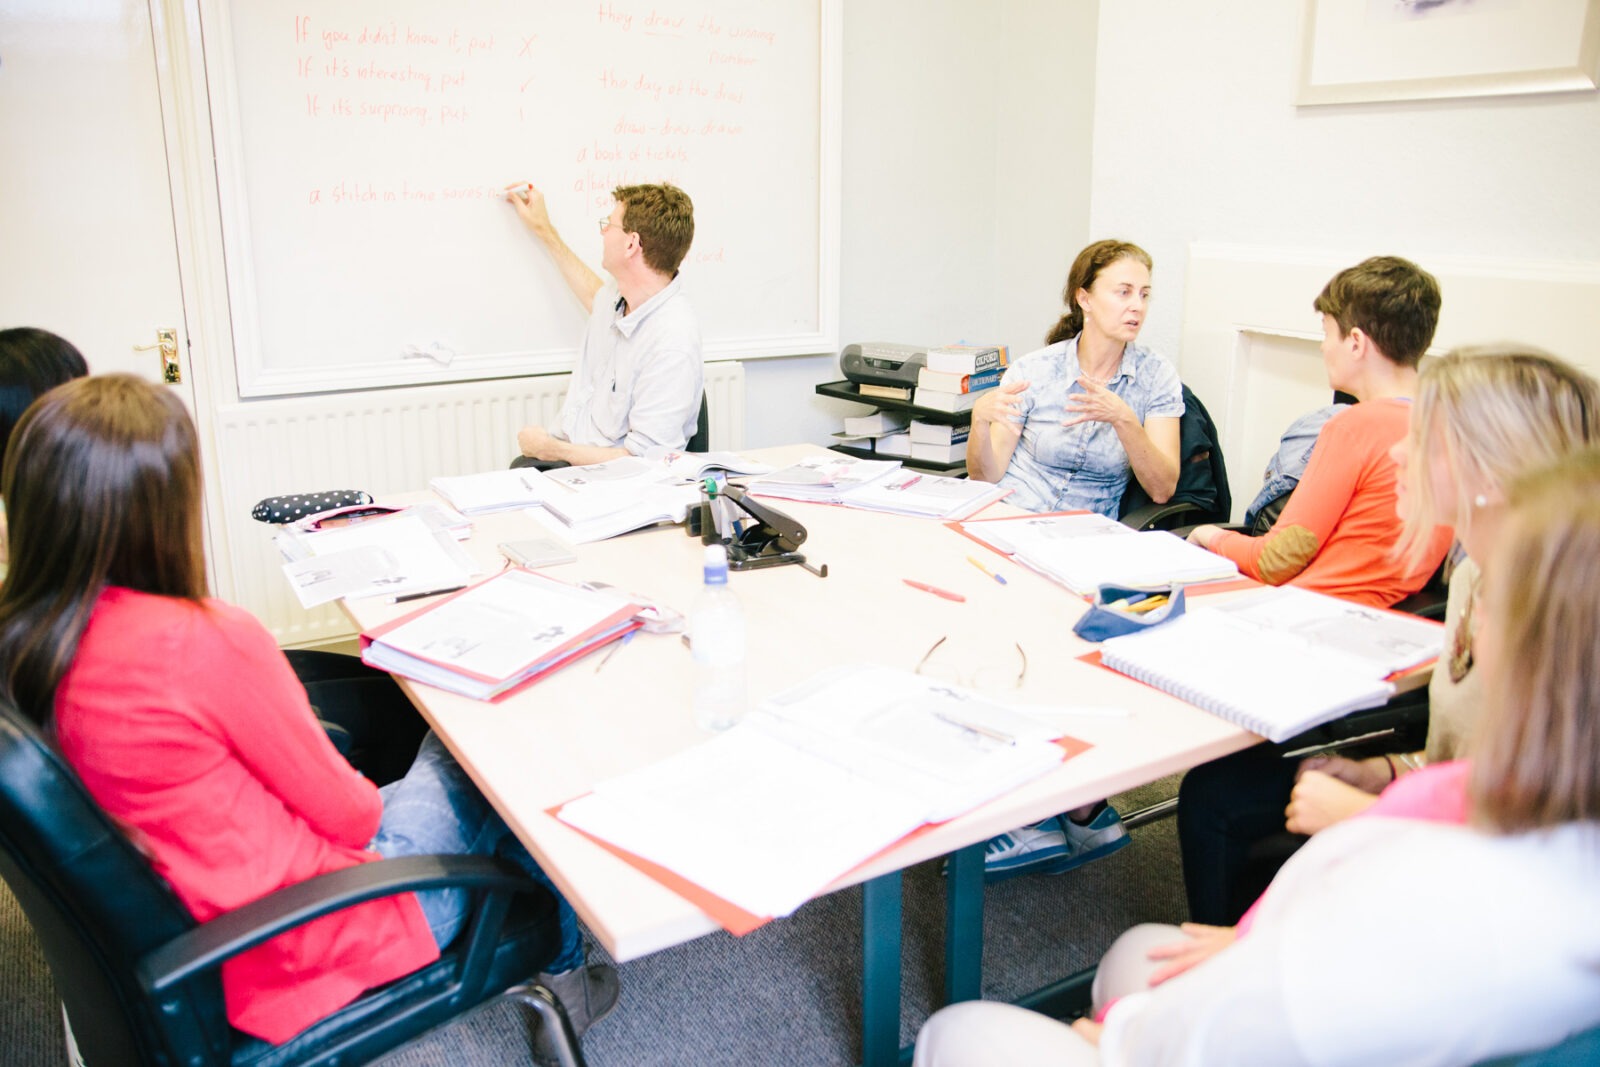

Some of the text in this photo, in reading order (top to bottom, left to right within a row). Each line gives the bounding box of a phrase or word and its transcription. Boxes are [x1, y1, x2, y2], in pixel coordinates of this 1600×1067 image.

[295, 15, 311, 43] If
[322, 30, 350, 51] you
[406, 25, 439, 45] know
[298, 55, 312, 78] If
[440, 70, 466, 93] put
[634, 72, 662, 103] day
[306, 92, 320, 117] If
[440, 104, 469, 127] put
[309, 189, 322, 206] a
[332, 178, 377, 204] stitch
[401, 179, 435, 202] time
